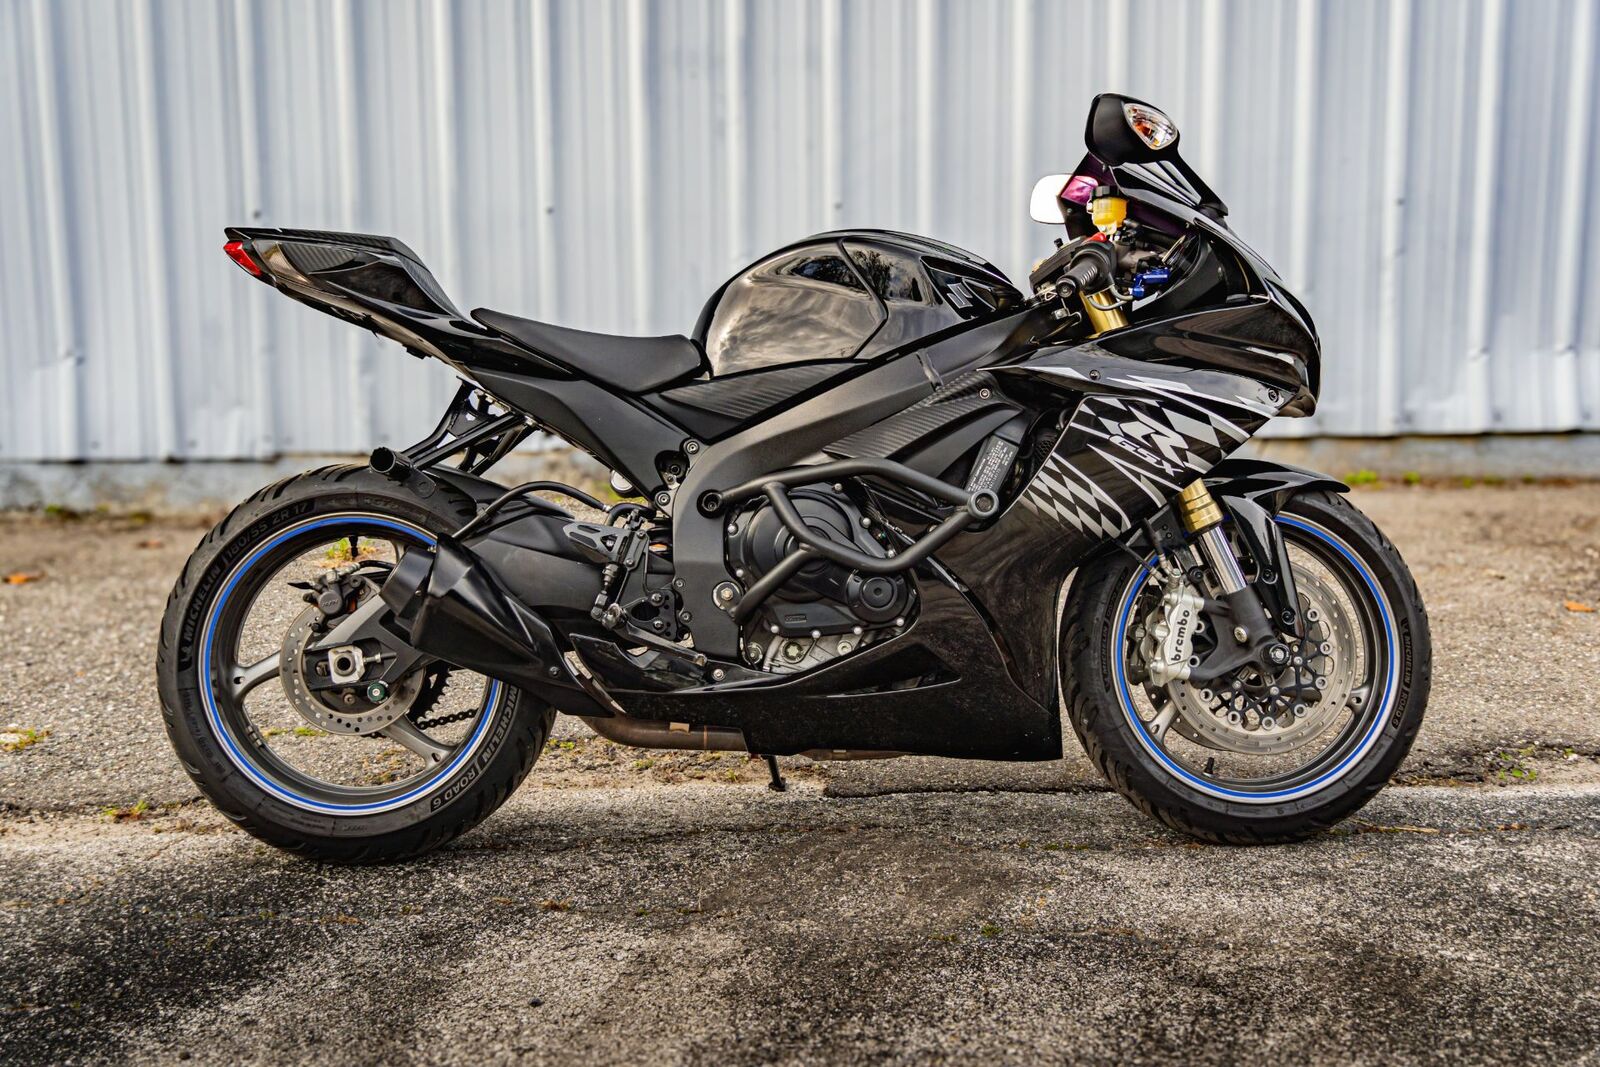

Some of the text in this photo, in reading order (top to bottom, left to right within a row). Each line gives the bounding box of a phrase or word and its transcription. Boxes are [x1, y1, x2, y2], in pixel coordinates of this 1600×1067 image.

[1109, 435, 1184, 477] GSX
[183, 567, 222, 642] MICHELIN
[226, 522, 268, 559] 180/55
[272, 511, 290, 524] ZR
[294, 503, 308, 514] 17
[1171, 609, 1190, 662] brembo
[1404, 636, 1412, 683] MICHELIN
[482, 686, 519, 762] MICHELIN
[1396, 693, 1409, 717] ROAD
[444, 771, 477, 800] ROAD
